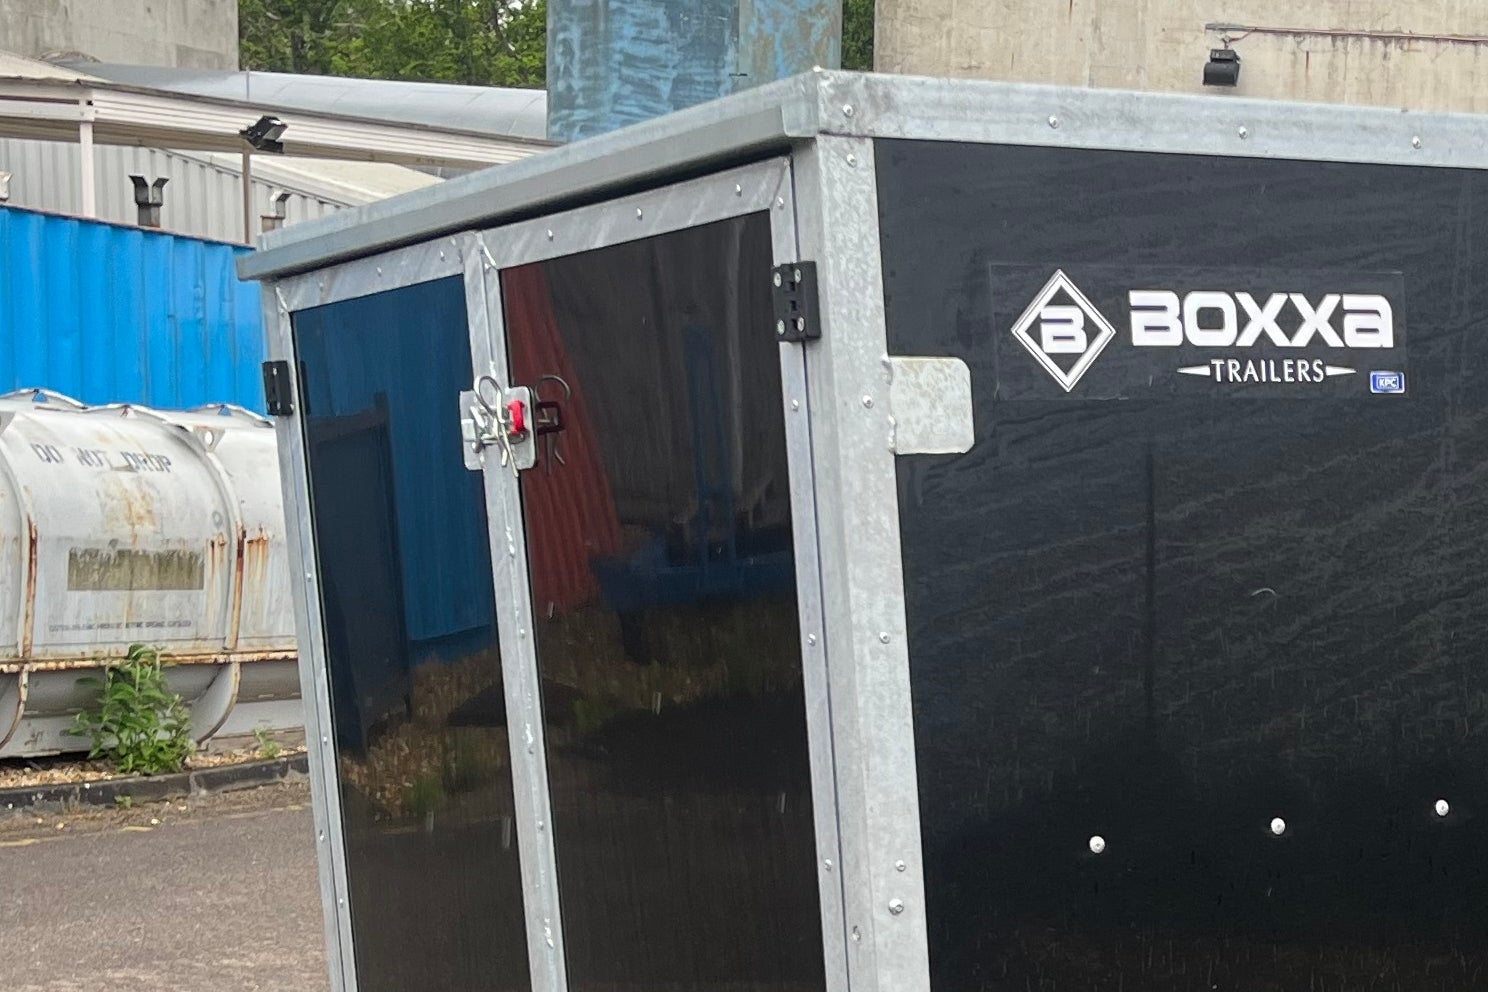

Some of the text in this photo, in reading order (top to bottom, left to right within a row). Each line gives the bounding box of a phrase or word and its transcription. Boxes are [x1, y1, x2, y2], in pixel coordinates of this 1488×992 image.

[1040, 304, 1088, 354] B
[1210, 358, 1325, 383] TRAILERS
[30, 442, 64, 464] DO
[120, 450, 172, 474] DROP
